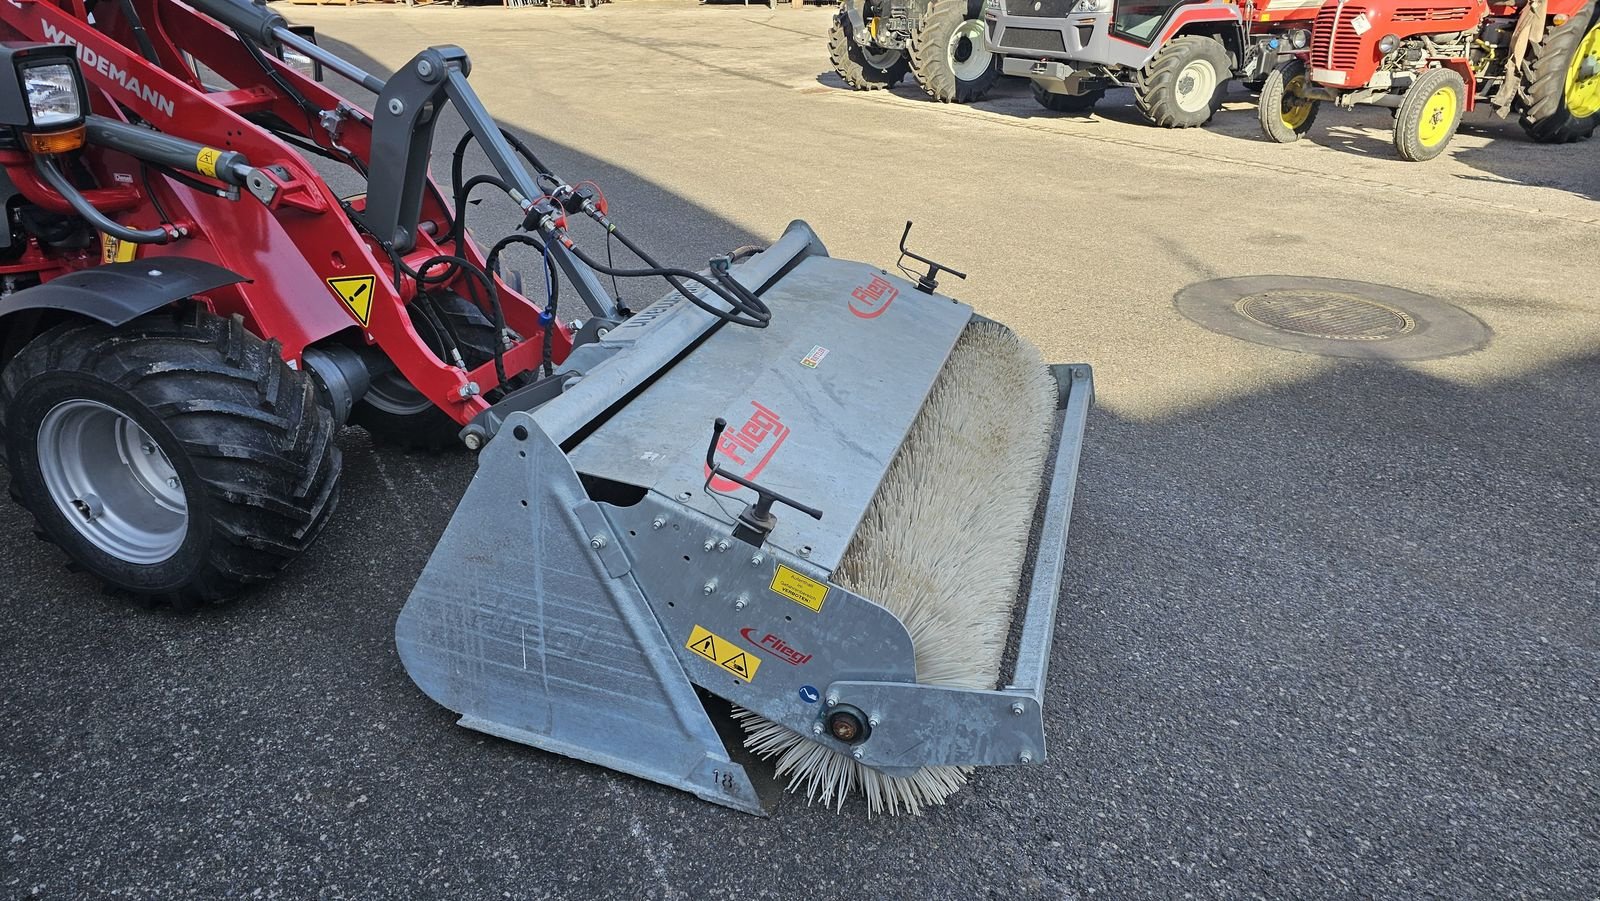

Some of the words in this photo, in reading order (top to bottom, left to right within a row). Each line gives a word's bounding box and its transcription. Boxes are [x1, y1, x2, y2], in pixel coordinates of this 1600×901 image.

[41, 18, 174, 117] WEIDEMANN
[851, 273, 896, 306] Fliegl
[717, 400, 784, 466] Fliegl
[761, 634, 813, 664] Fliegl
